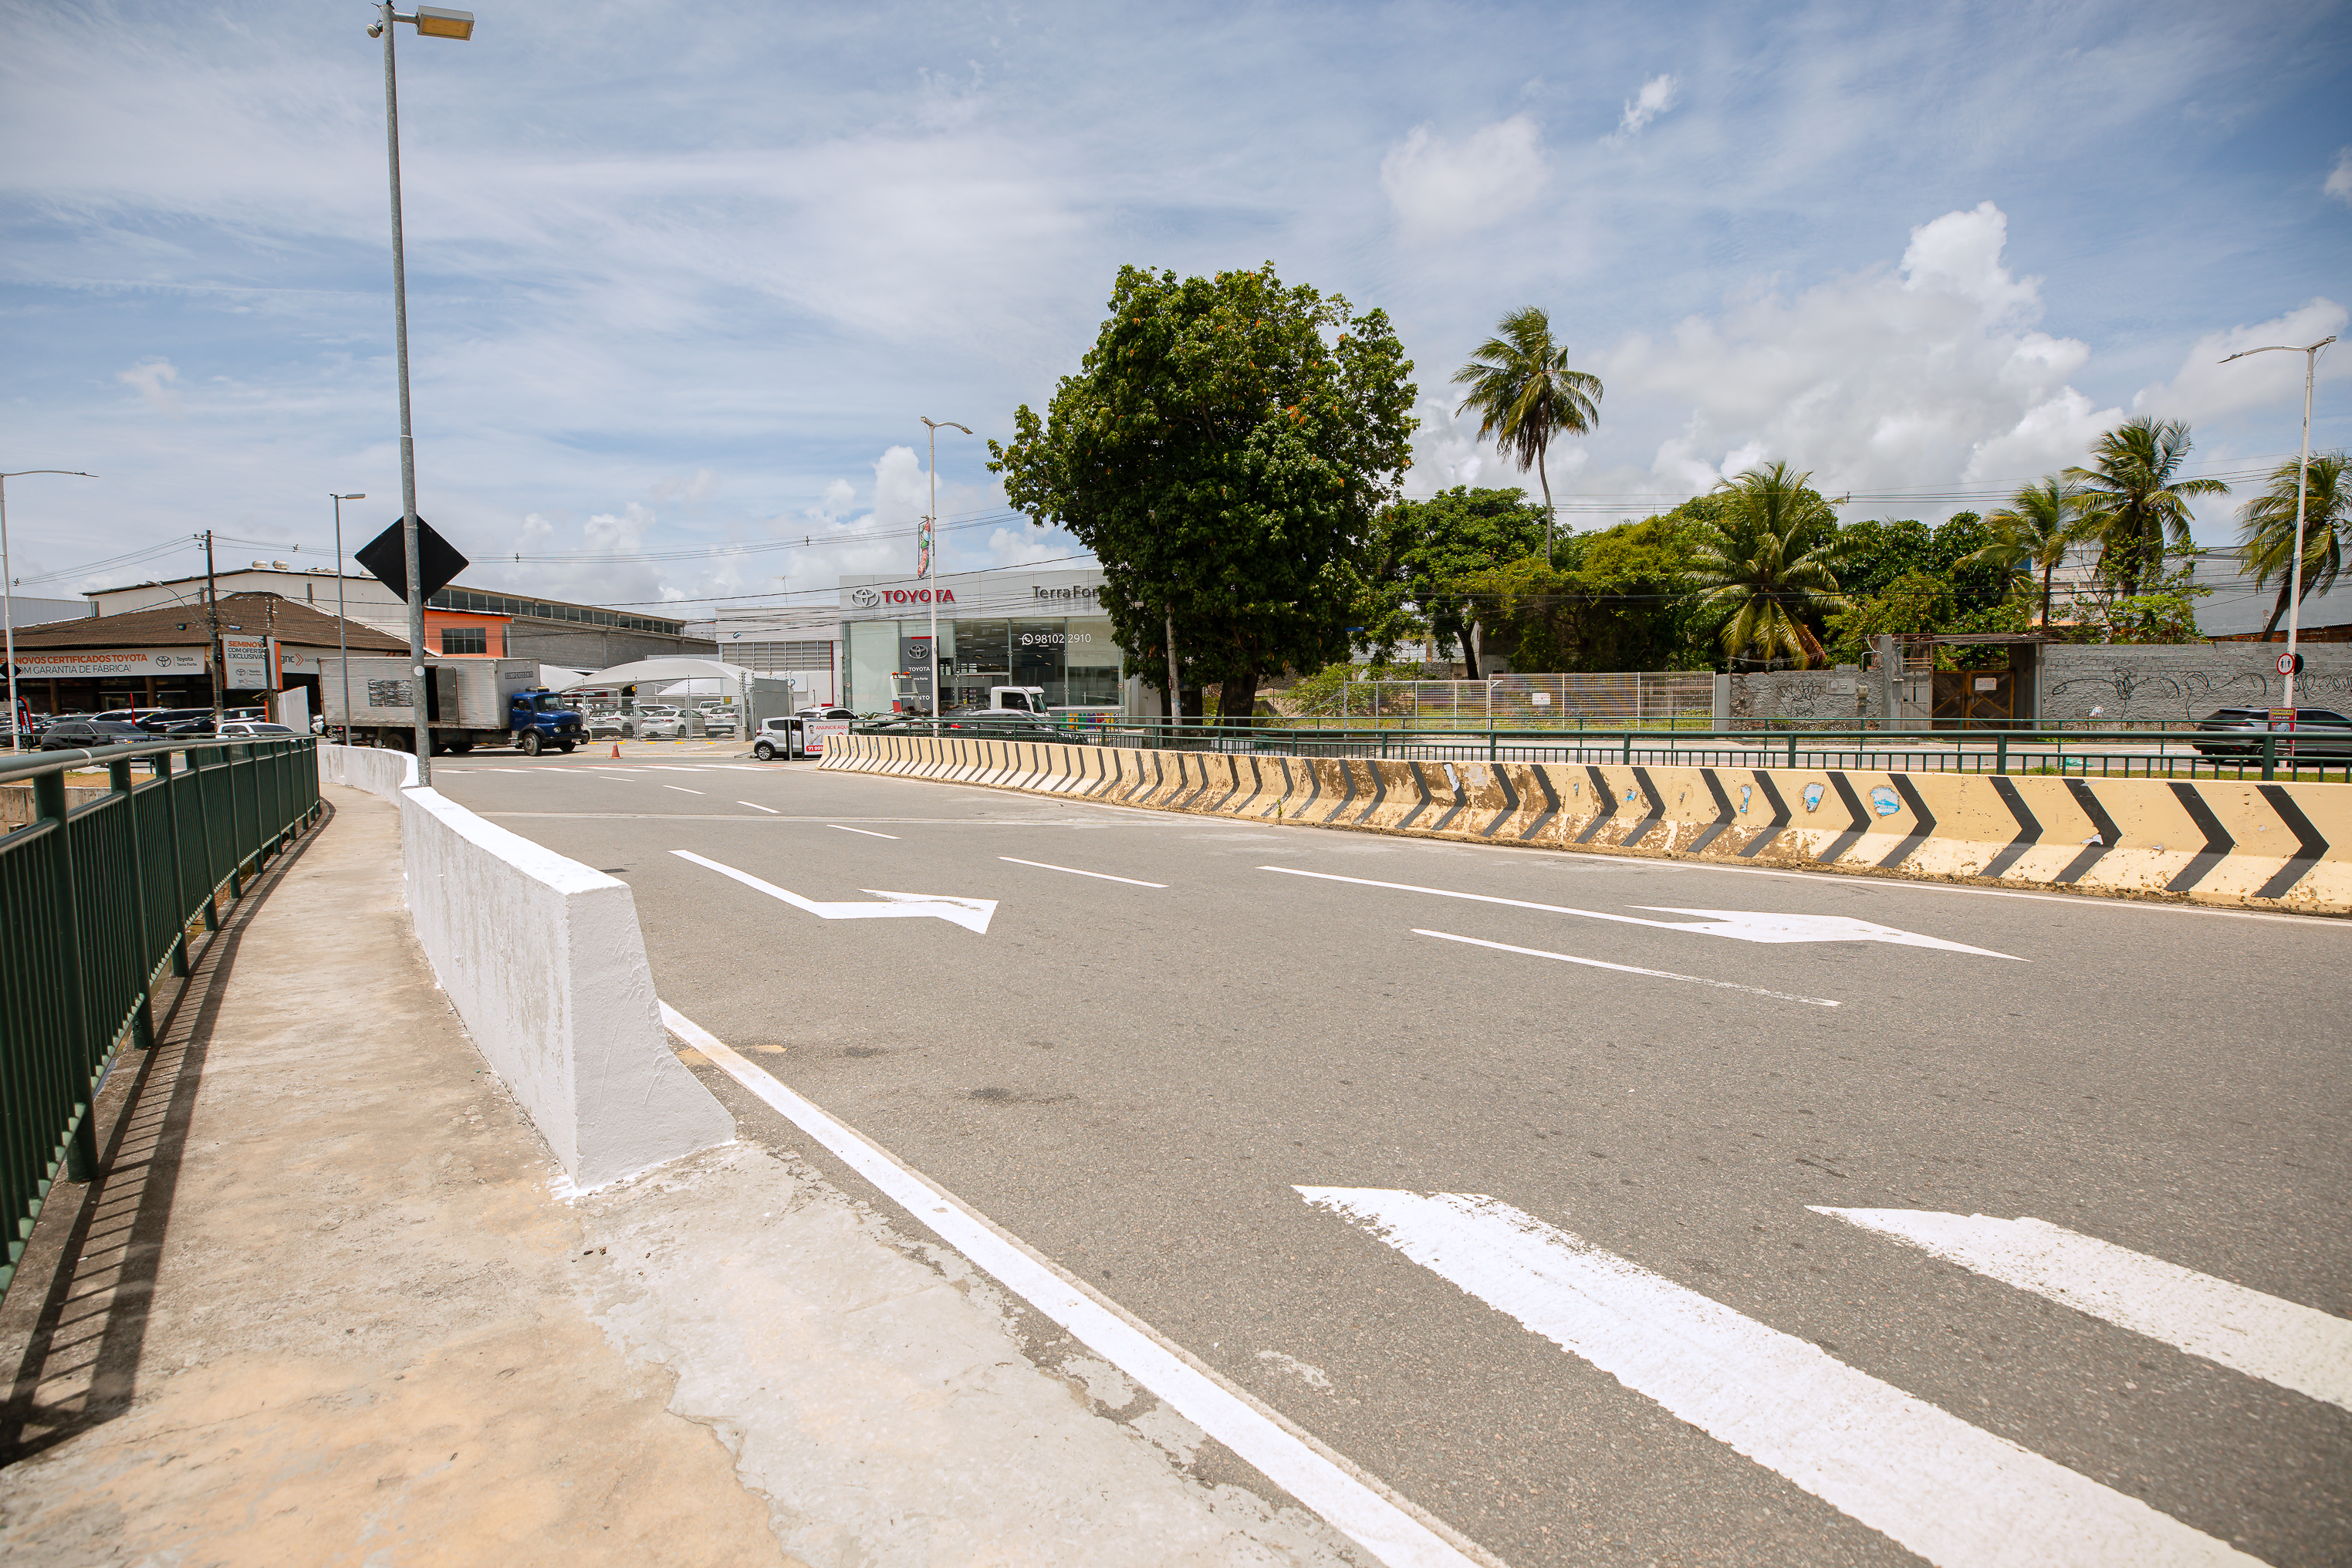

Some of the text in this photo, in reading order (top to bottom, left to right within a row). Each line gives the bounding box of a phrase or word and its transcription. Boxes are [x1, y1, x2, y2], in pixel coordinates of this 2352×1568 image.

[882, 589, 955, 603] TOYOTA
[1035, 634, 1091, 644] 98102 2910
[47, 655, 111, 664] CERTIFICADOS
[111, 654, 149, 662] TOYOTA
[32, 665, 78, 674] GARANTIA
[93, 663, 131, 674] FÁBRICA!
